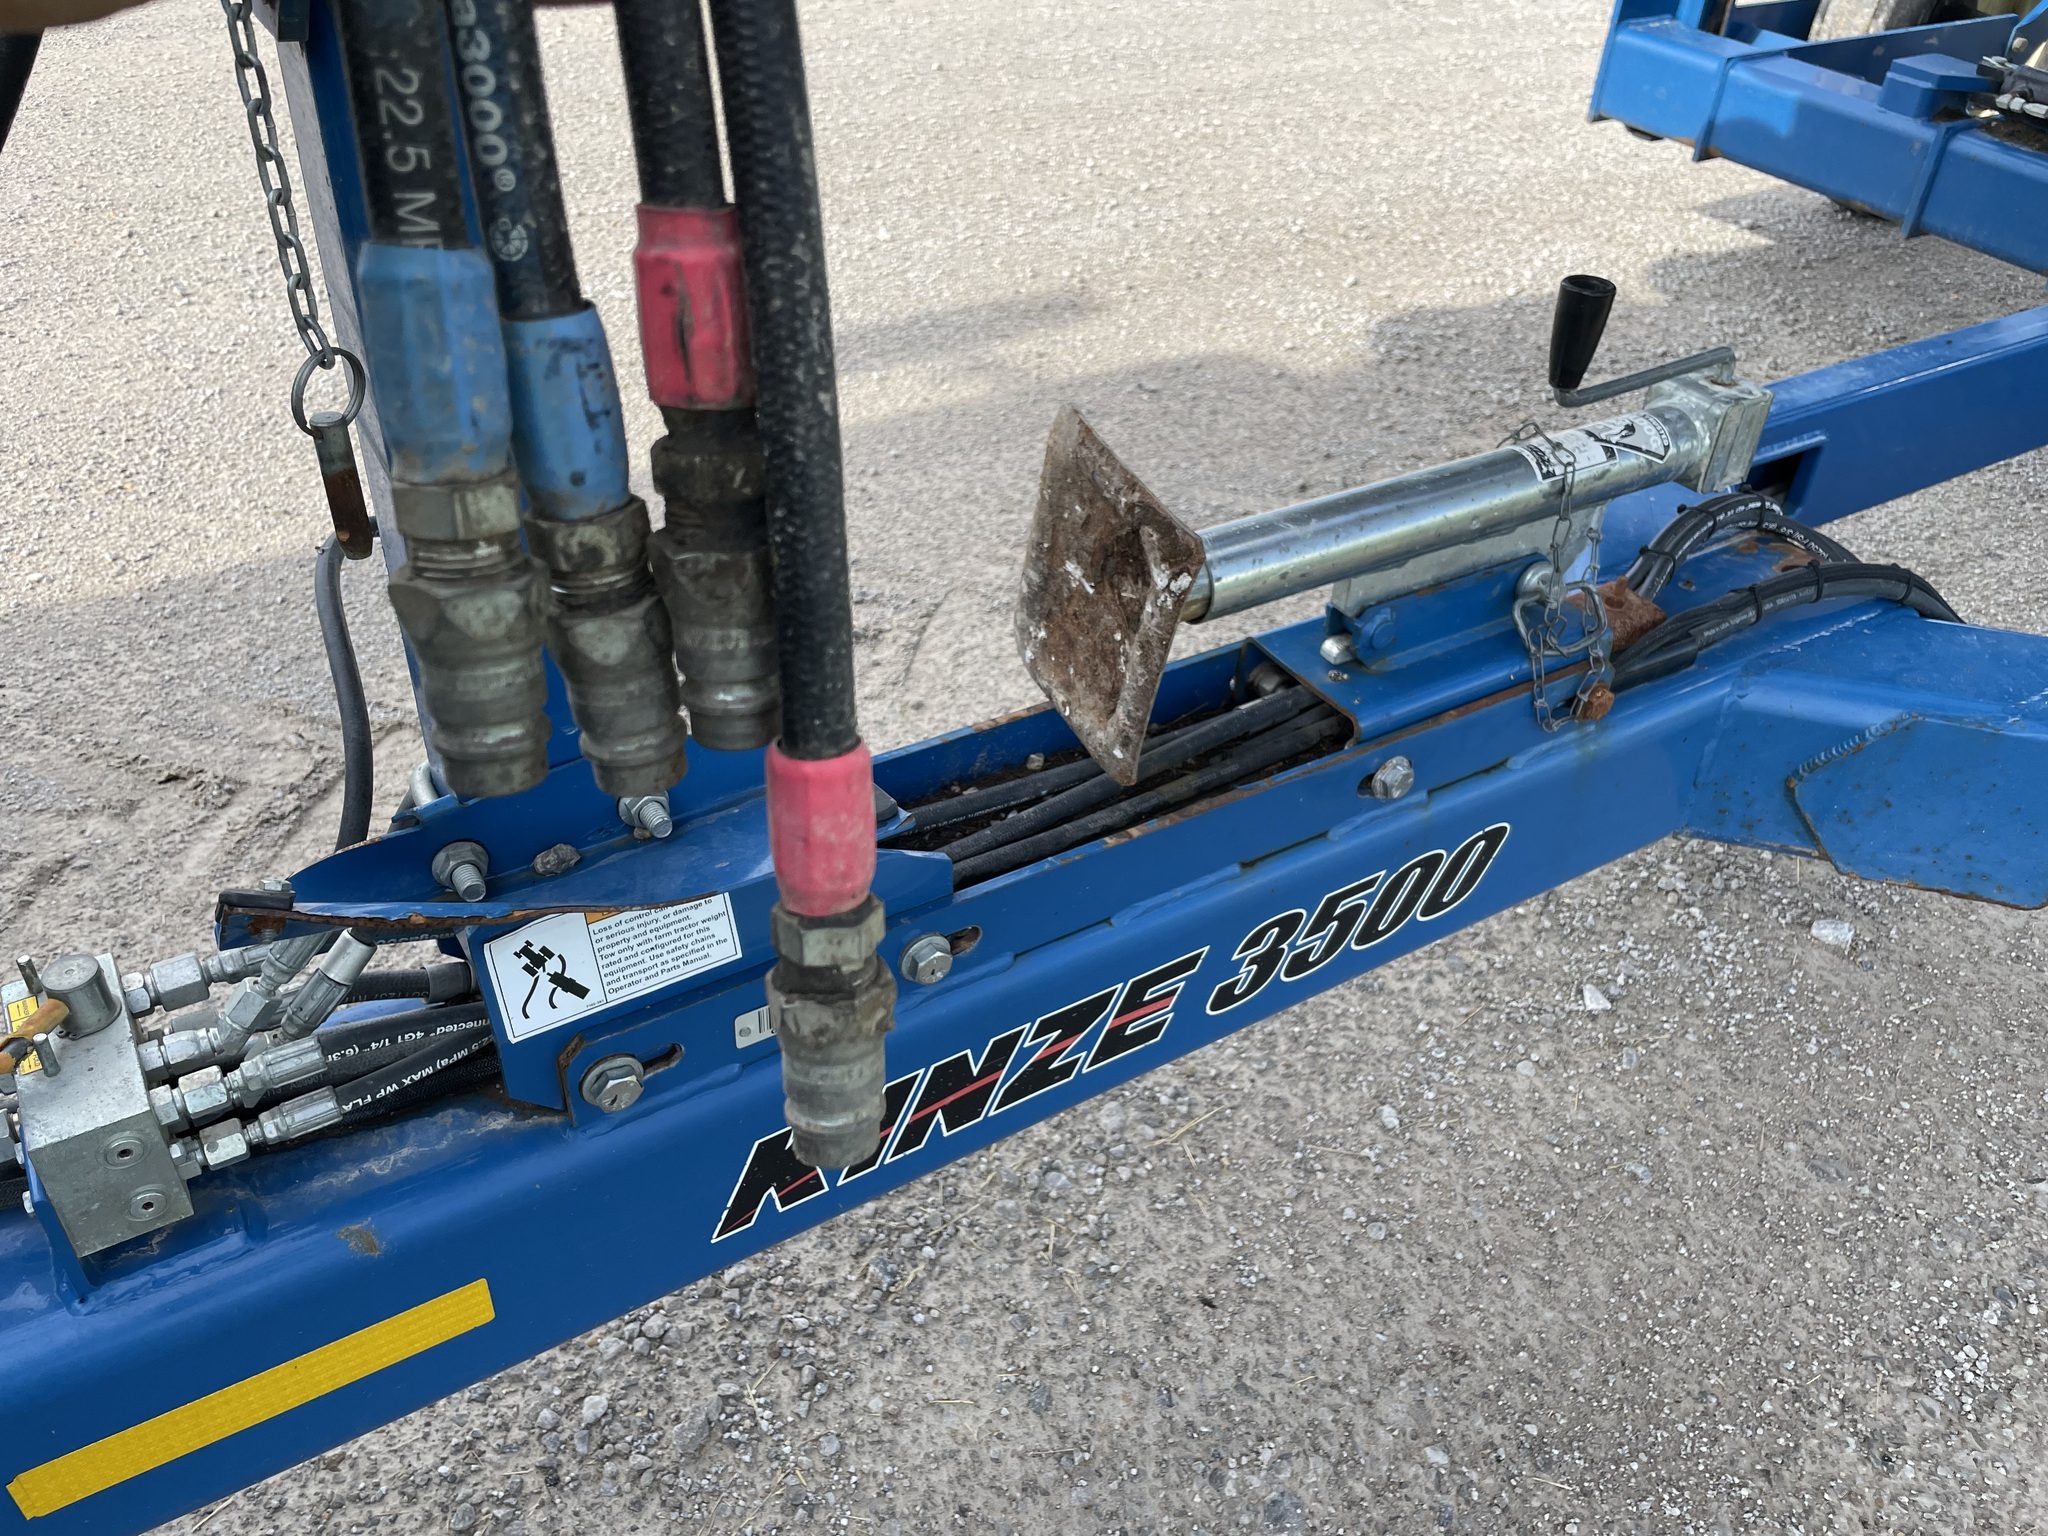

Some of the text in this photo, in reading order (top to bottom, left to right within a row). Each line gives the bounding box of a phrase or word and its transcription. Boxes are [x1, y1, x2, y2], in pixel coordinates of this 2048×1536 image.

[375, 68, 431, 172] 22.5
[592, 924, 613, 936] Loss
[614, 919, 623, 928] of
[624, 911, 653, 924] control
[595, 936, 604, 944] or
[605, 926, 635, 940] serious
[636, 917, 662, 929] injury,
[672, 901, 703, 917] damage
[597, 914, 692, 954] property and equipment.
[599, 910, 726, 961] Tow only with farm tractor weight
[1206, 822, 1511, 1016] 3500
[601, 925, 711, 970] rated and configured for this
[603, 933, 716, 978] equipment. Use safety chains
[606, 976, 621, 987] and
[622, 962, 659, 981] transport
[660, 959, 670, 967] as
[671, 944, 706, 962] specified
[715, 937, 728, 946] the
[608, 952, 713, 994] Operator and Parts Manual.
[397, 1030, 425, 1044] 4G1
[402, 1067, 434, 1087] MAX
[436, 1047, 469, 1070] MPa)
[341, 1094, 372, 1112] FLA
[375, 1082, 400, 1099] WP
